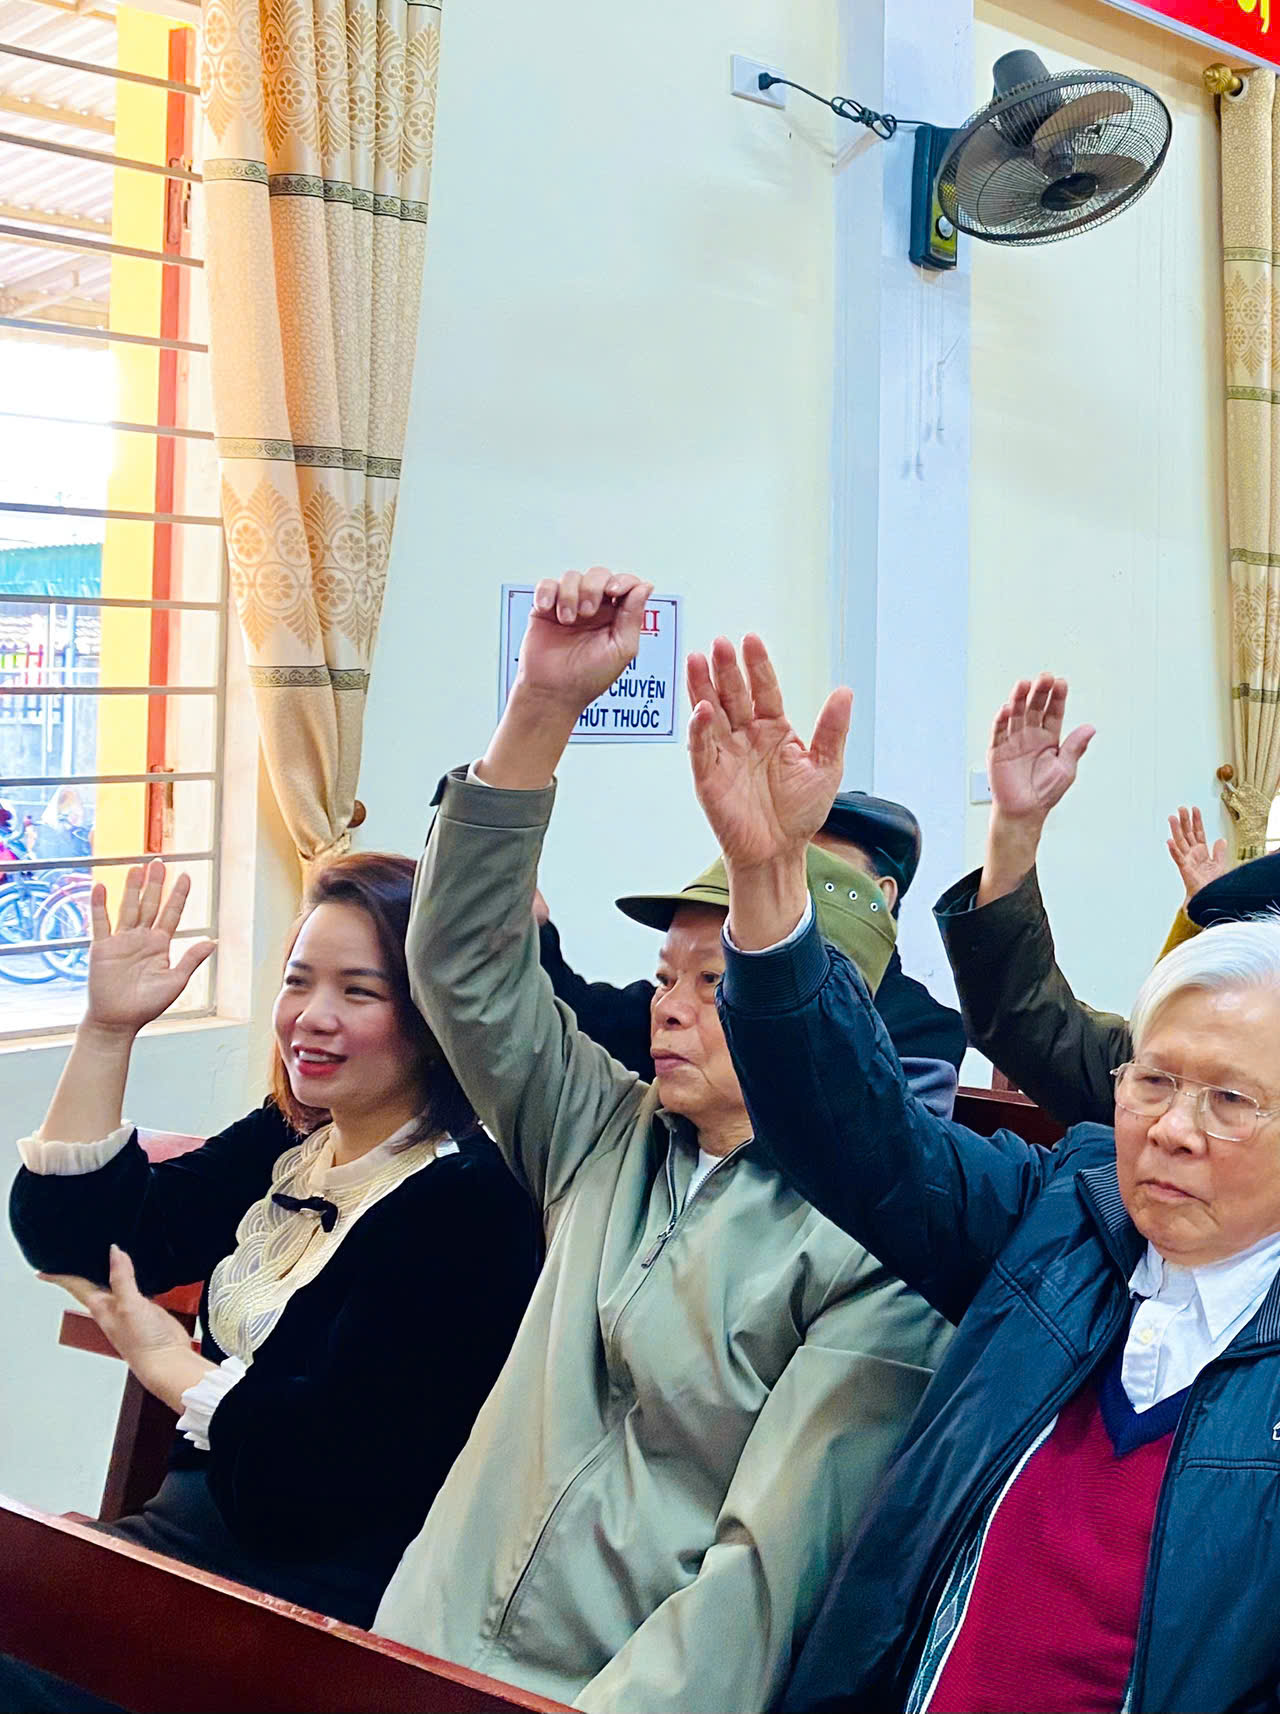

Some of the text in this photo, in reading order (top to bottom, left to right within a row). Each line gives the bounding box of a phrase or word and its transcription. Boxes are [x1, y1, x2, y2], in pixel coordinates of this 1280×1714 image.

[609, 675, 666, 703] CHUYỆN
[579, 699, 660, 728] HÚT THUỐC
